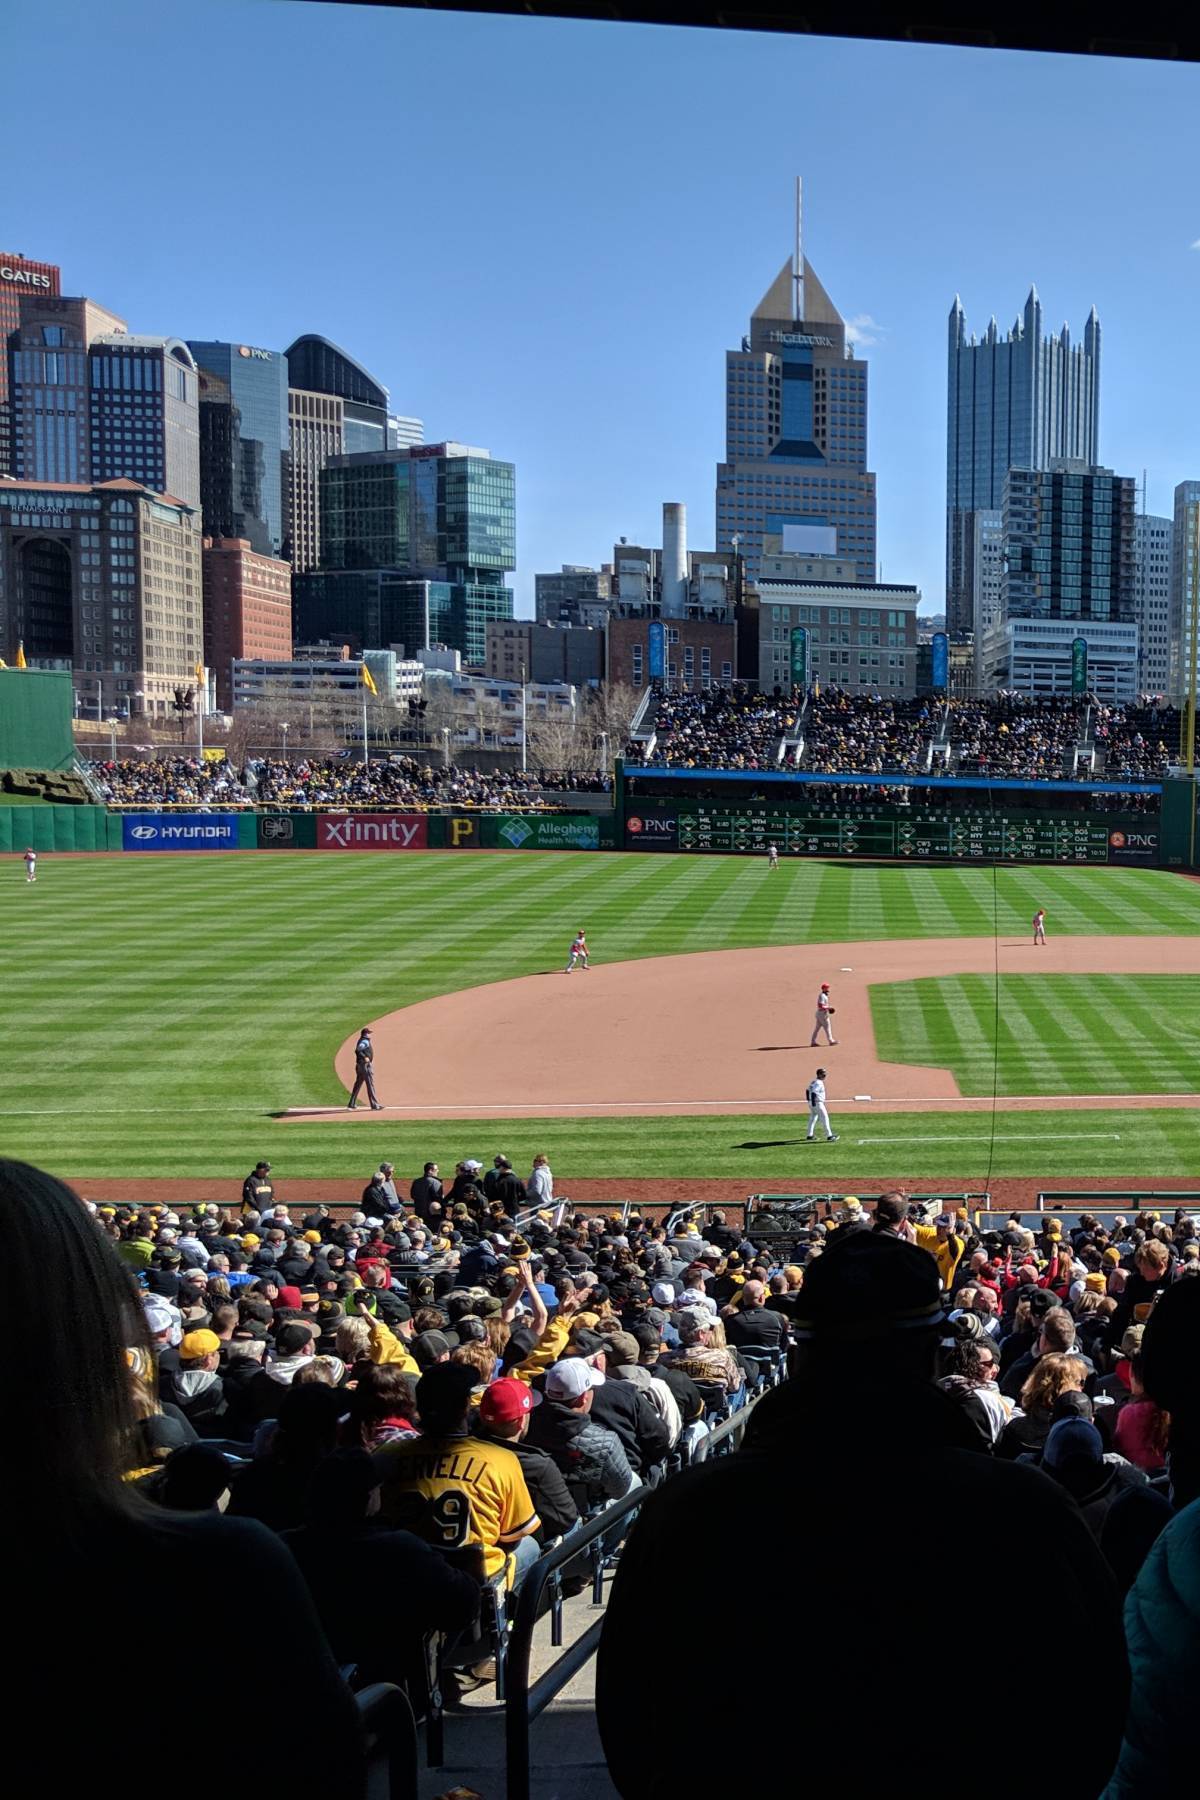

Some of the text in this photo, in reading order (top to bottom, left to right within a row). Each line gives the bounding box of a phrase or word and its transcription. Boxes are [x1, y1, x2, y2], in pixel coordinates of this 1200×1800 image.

[1, 267, 50, 288] GATES
[251, 348, 272, 360] PNC
[11, 504, 68, 514] RENAISSANCE
[698, 808, 875, 820] NATIONAL LEAGUE
[645, 819, 676, 832] PNC
[916, 816, 1091, 827] AMERICAN LEAGUE
[162, 827, 230, 838] HYUNDAI
[325, 818, 419, 846] xfinity
[452, 818, 473, 846] P
[538, 823, 599, 836] Allegheny
[538, 837, 562, 845] Health
[1127, 834, 1158, 846] PNC
